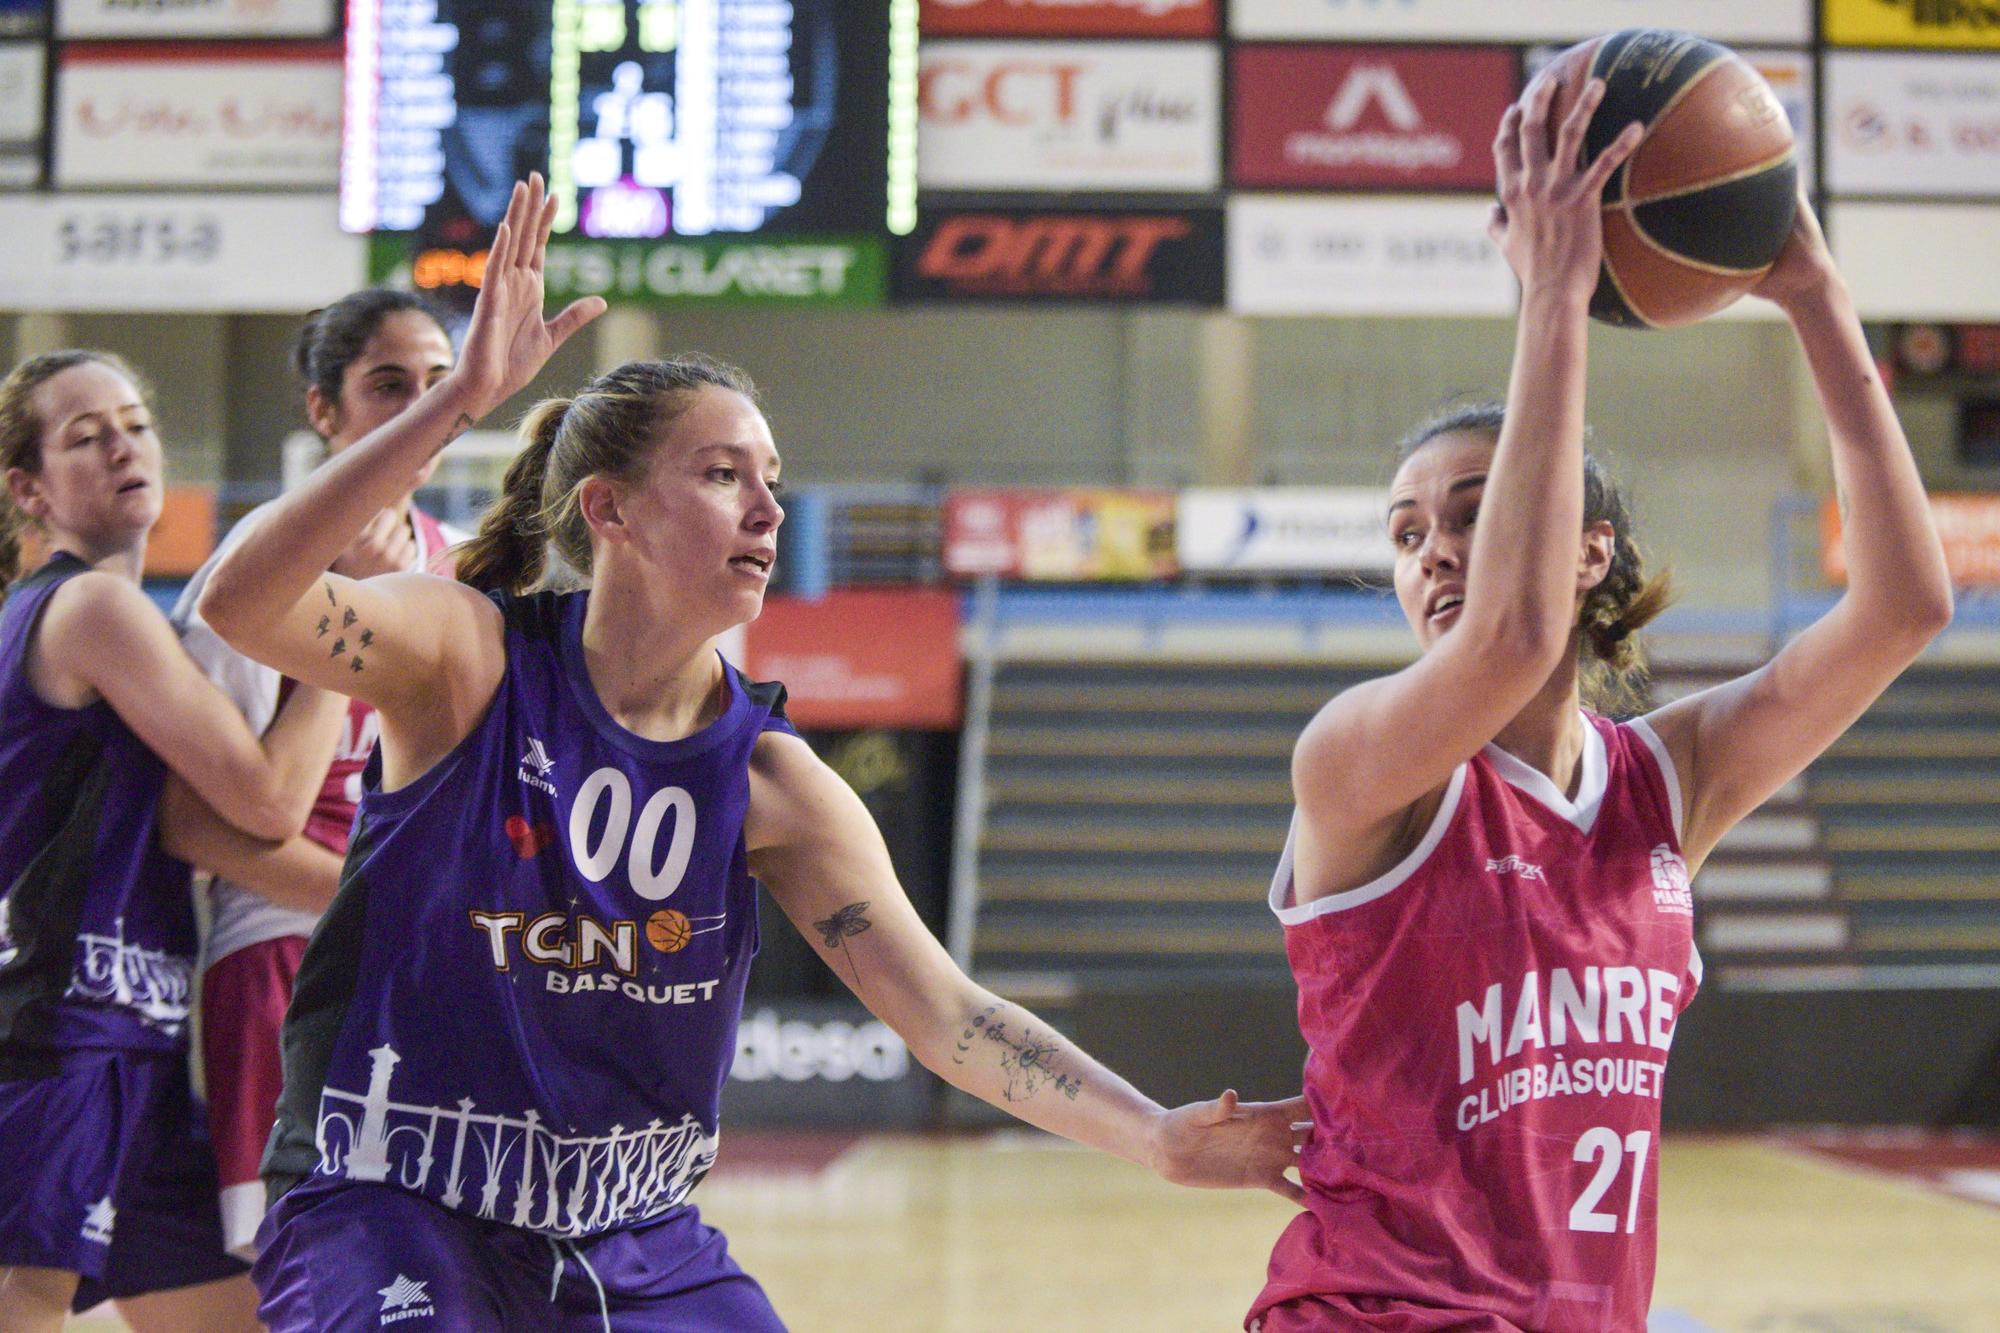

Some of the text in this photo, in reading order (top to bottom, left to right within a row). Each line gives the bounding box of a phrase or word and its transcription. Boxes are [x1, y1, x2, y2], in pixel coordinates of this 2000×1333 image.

[918, 57, 1096, 130] GCT
[59, 212, 222, 264] sarsa
[568, 766, 697, 901] 00
[469, 910, 638, 977] TGN
[1568, 1126, 1652, 1235] 21
[379, 1305, 435, 1327] luanvi
